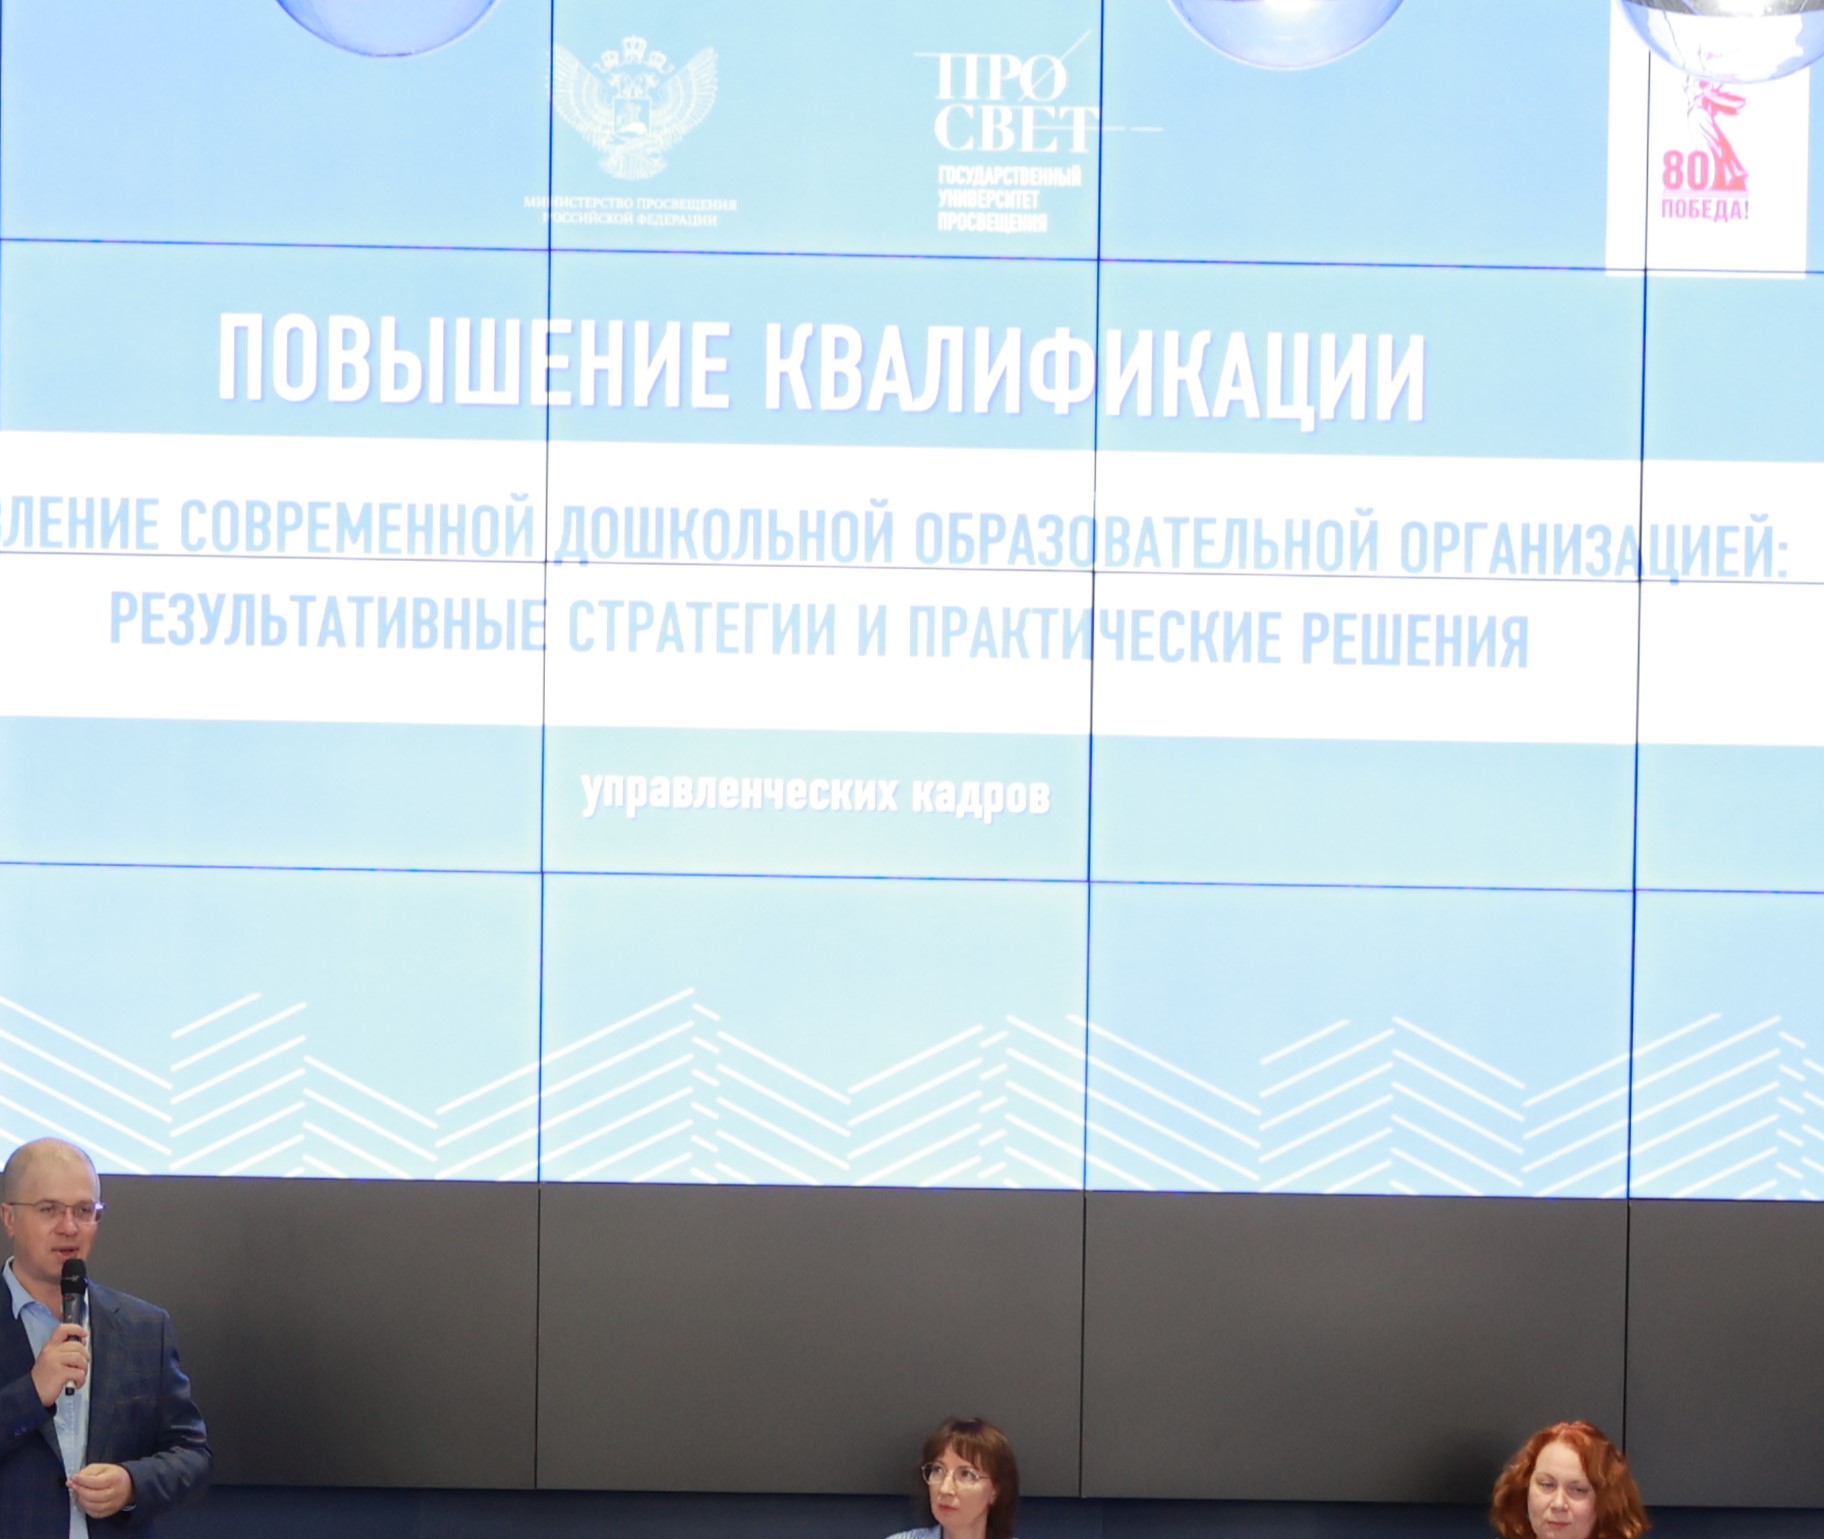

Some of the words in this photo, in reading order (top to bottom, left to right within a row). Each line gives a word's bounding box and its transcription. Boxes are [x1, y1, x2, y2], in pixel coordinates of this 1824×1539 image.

[935, 53, 1068, 102] ПРО
[934, 104, 1101, 153] СВЕТ
[938, 165, 1082, 187] ГОСУДАРСТВЕННЫЙ
[1662, 149, 1709, 190] 80
[524, 196, 634, 210] МИНИСТЕРСТВО
[637, 198, 737, 212] ПРОСВЕЩЕНИЯ
[542, 211, 633, 225] РОССИЙСКОЙ
[637, 213, 718, 227] ФЕДЕРАЦИИ
[938, 188, 1040, 210] УНИВЕРСИТЕТ
[1662, 198, 1749, 223] ПОБЕДА!
[937, 211, 1048, 234] ПРОСВЕЩЕНИЯ
[219, 312, 731, 410] ПОВЫШЕНИЕ
[764, 322, 1426, 433] КВАЛИФИКАЦИИ
[179, 493, 535, 557] СОВРЕМЕННОЙ
[554, 497, 894, 566] ДОШКОЛЬНОЙ
[914, 507, 1378, 573] ОБРАЗОВАТЕЛЬНОЙ
[1400, 513, 1790, 586] ОРГАНИЗАЦИЕЙ:
[110, 590, 547, 653] РЕЗУЛЬТАТИВНЫЕ
[569, 598, 837, 656] СТРАТЕГИИ
[857, 603, 888, 657] И
[908, 605, 1283, 665] ПРАКТИЧЕСКИЕ
[1302, 611, 1530, 669] РЕШЕНИЯ
[580, 773, 899, 818] управленческих
[912, 779, 1051, 824] кадров
